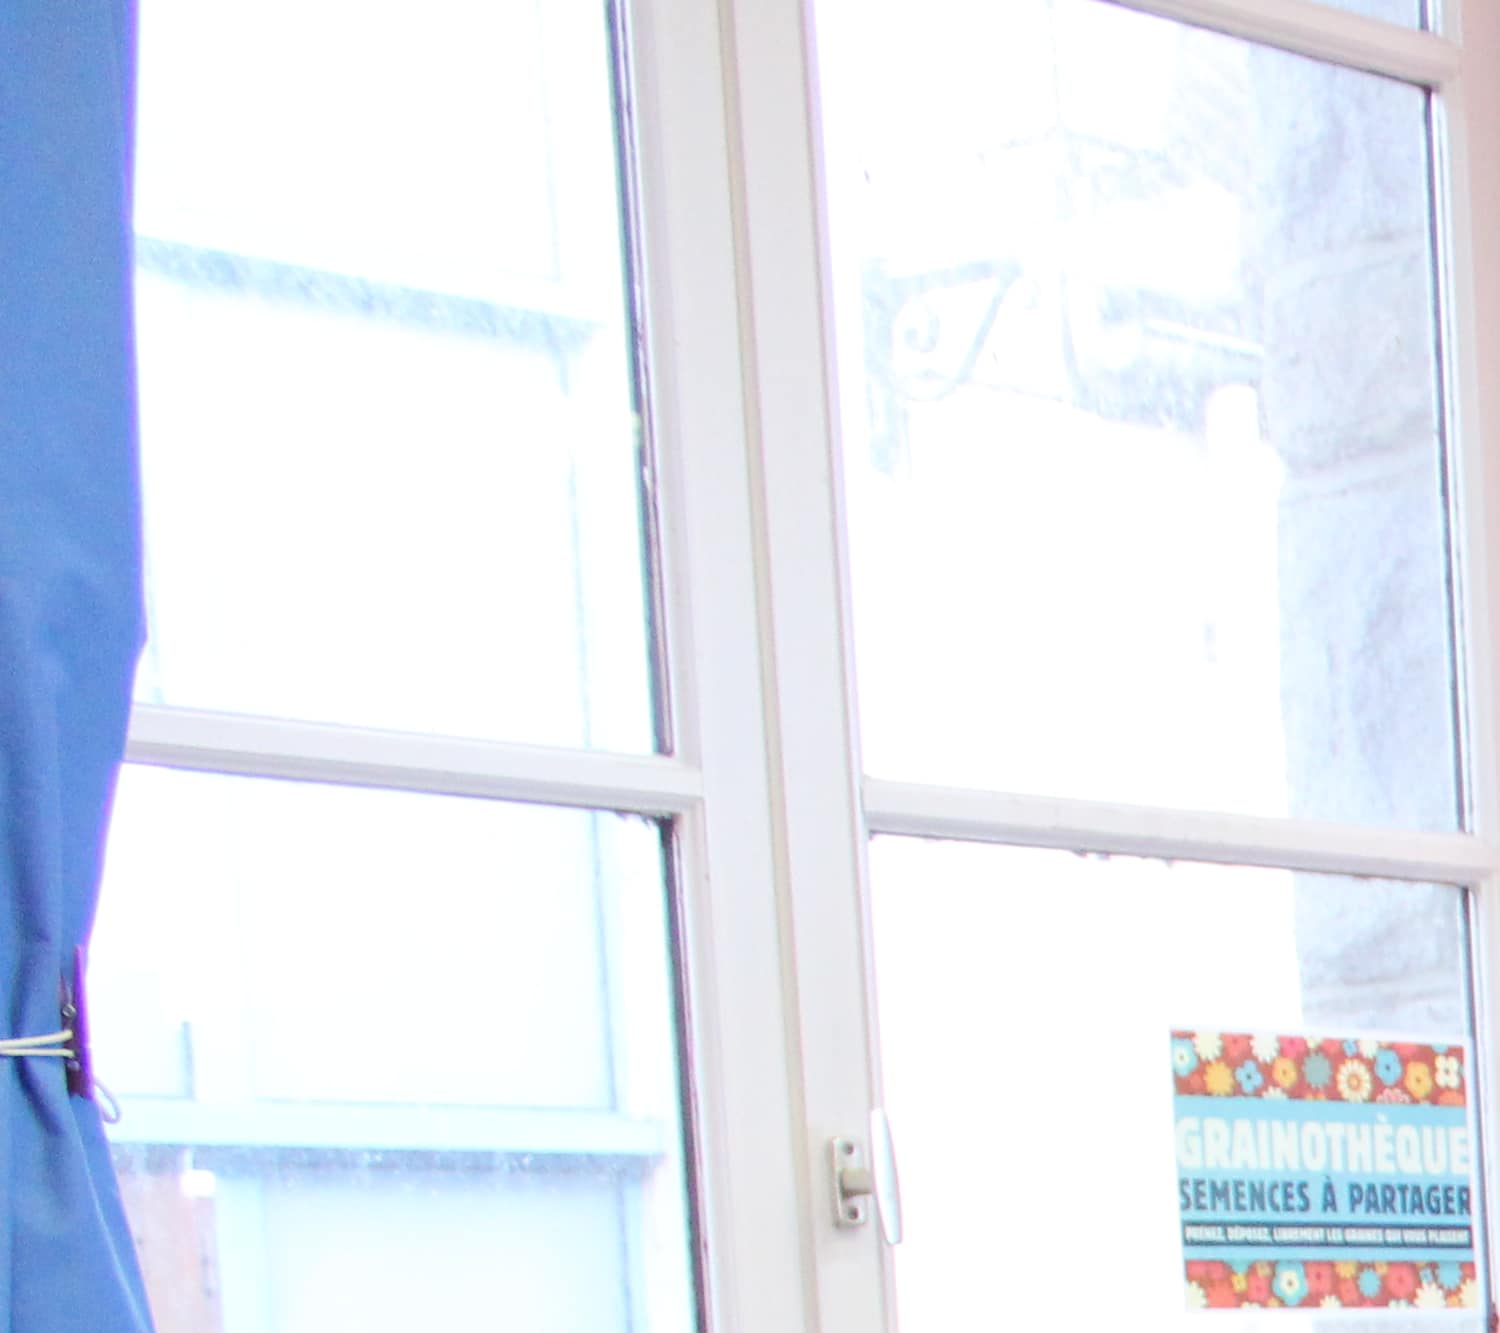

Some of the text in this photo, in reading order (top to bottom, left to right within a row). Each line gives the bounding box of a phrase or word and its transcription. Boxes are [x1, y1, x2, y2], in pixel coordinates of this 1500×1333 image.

[1175, 1113, 1471, 1176] GRAINOTHÈQUE
[1180, 1175, 1471, 1216] SEMENCES À PARTAGER
